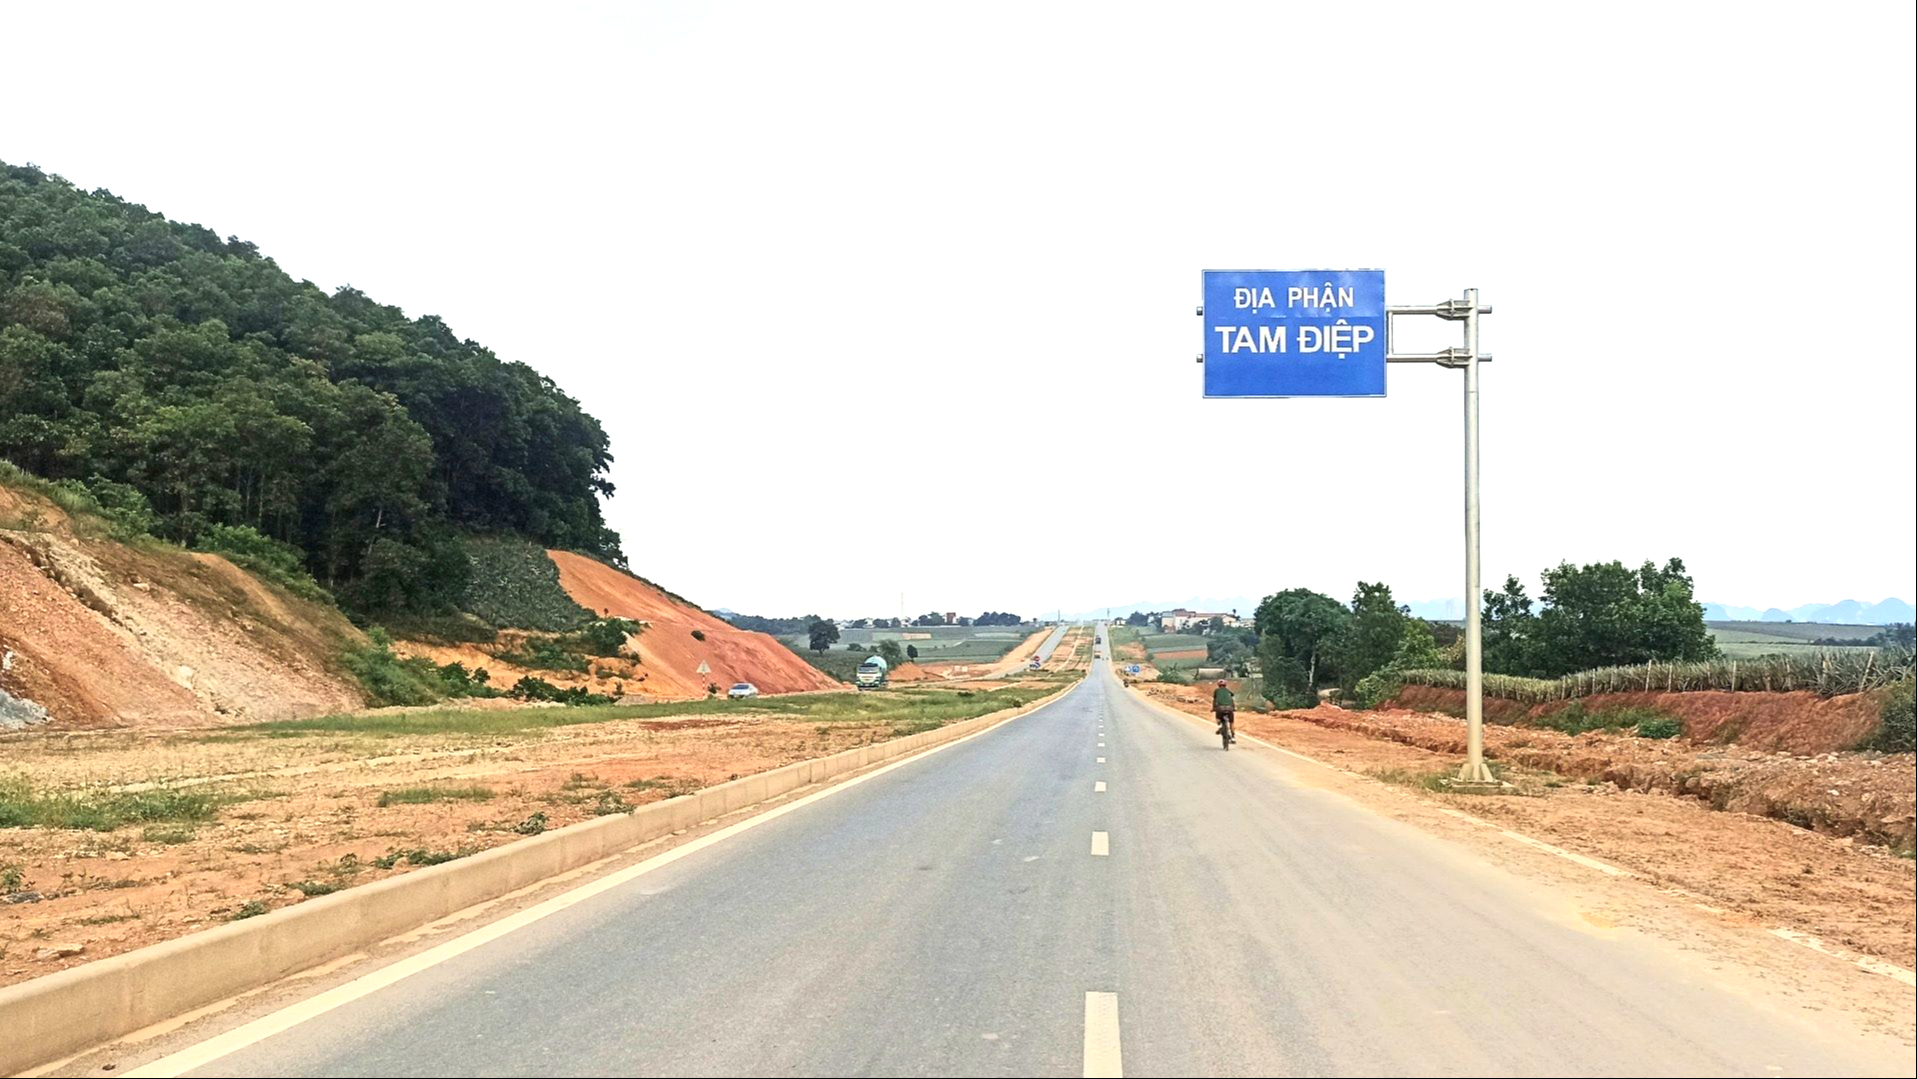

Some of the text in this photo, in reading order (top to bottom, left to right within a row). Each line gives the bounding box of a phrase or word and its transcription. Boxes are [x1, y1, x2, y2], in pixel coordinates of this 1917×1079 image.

[1234, 281, 1354, 313] ĐỊA PHẬN
[1215, 319, 1374, 359] TAM ĐIỆP
